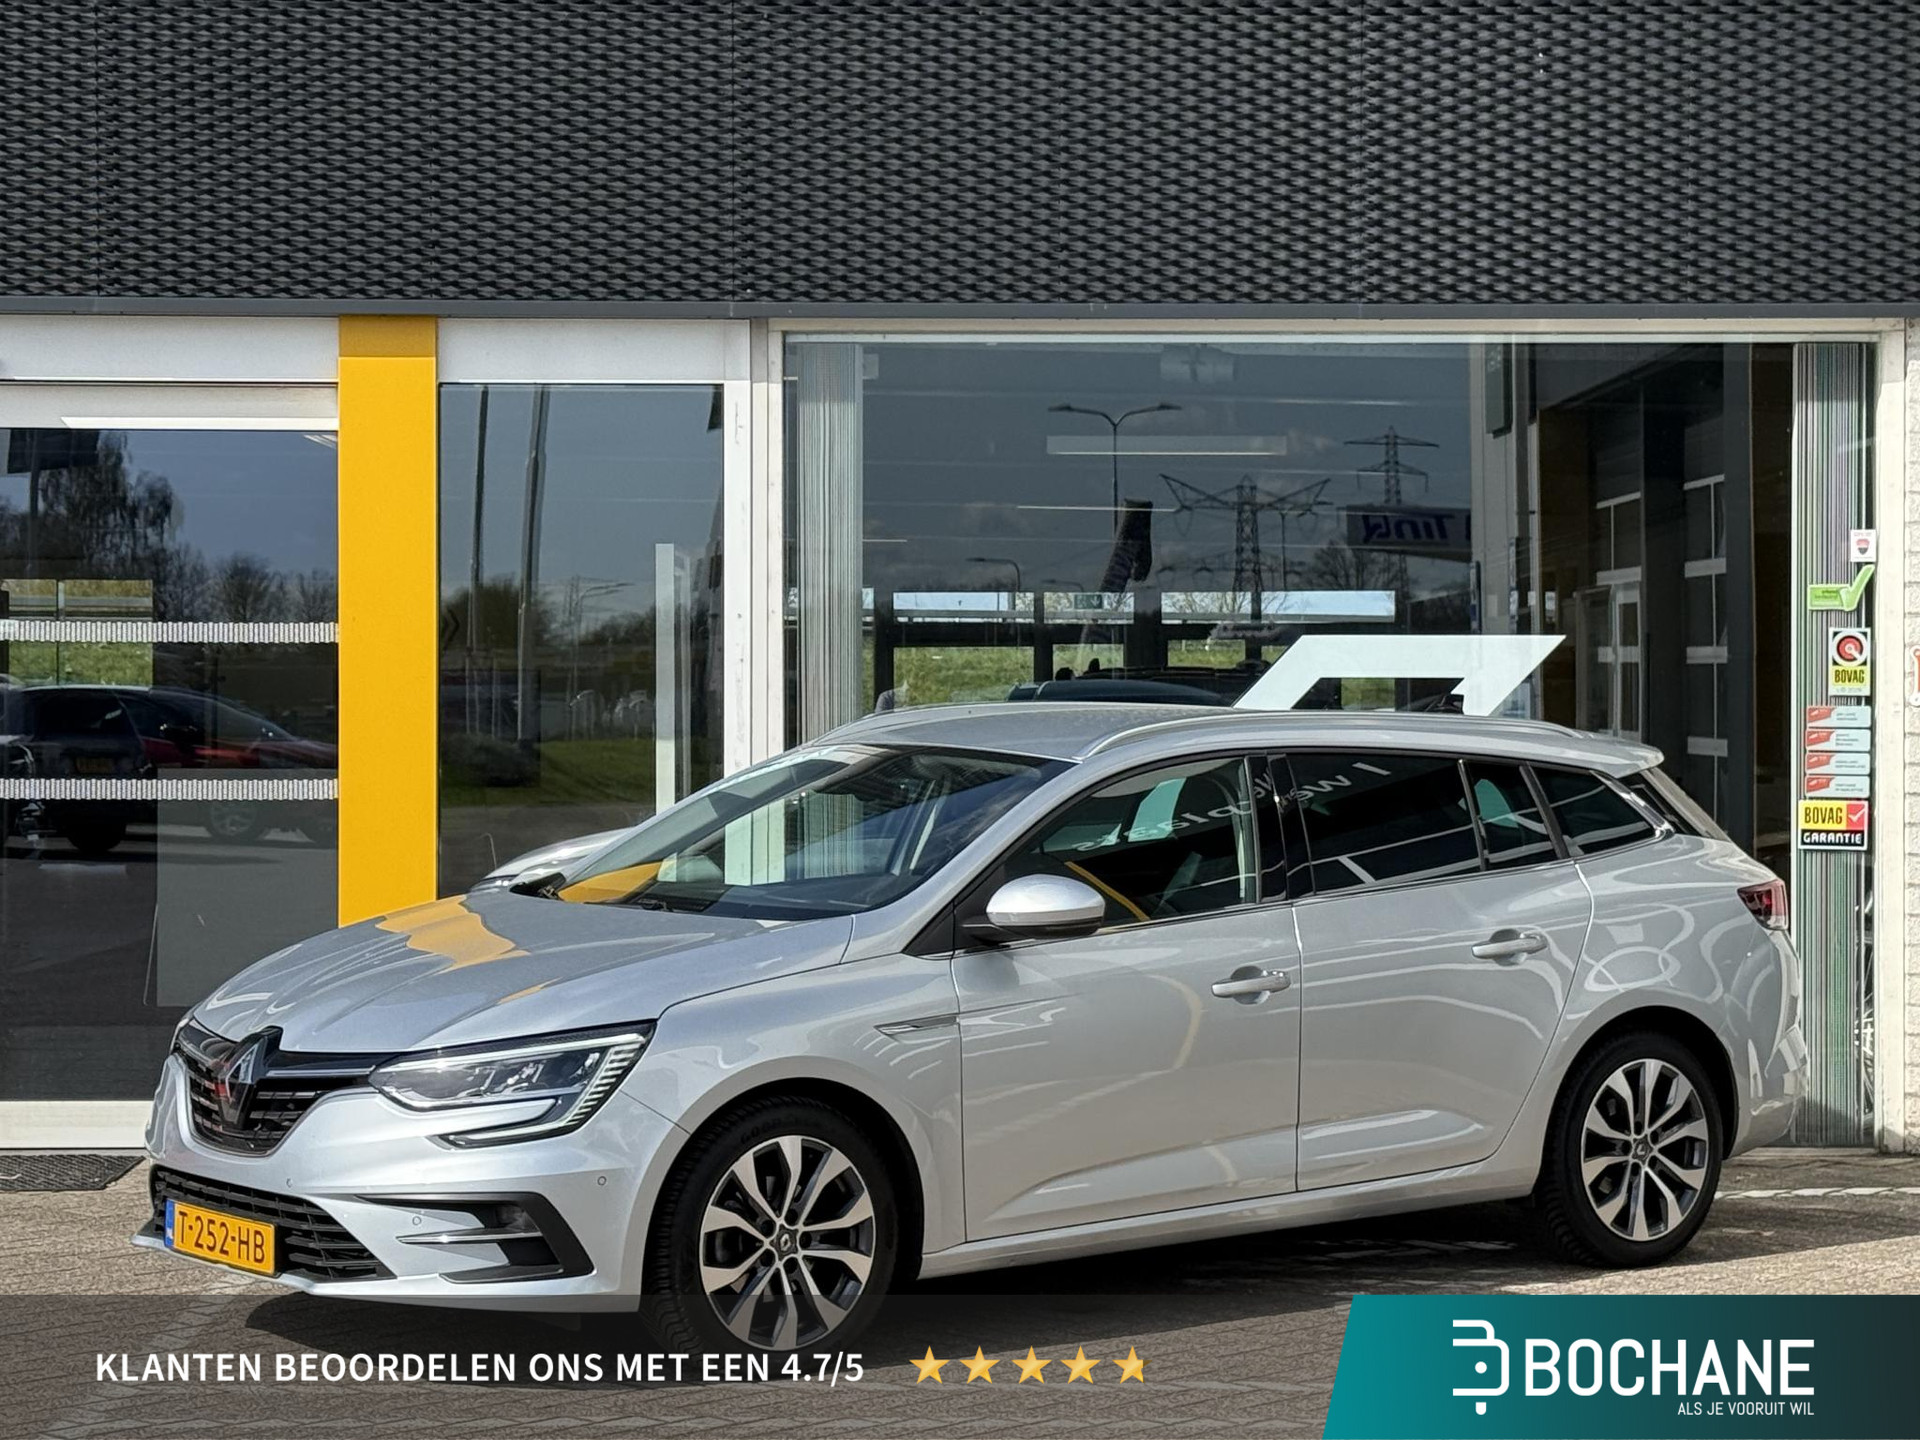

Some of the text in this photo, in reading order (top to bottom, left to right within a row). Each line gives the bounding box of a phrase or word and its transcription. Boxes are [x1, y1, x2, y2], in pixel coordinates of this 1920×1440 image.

[1834, 669, 1865, 683] BOVAG
[1804, 806, 1843, 825] BOVAG
[1803, 832, 1862, 844] GARANTIE
[178, 1210, 265, 1264] T-252-HB
